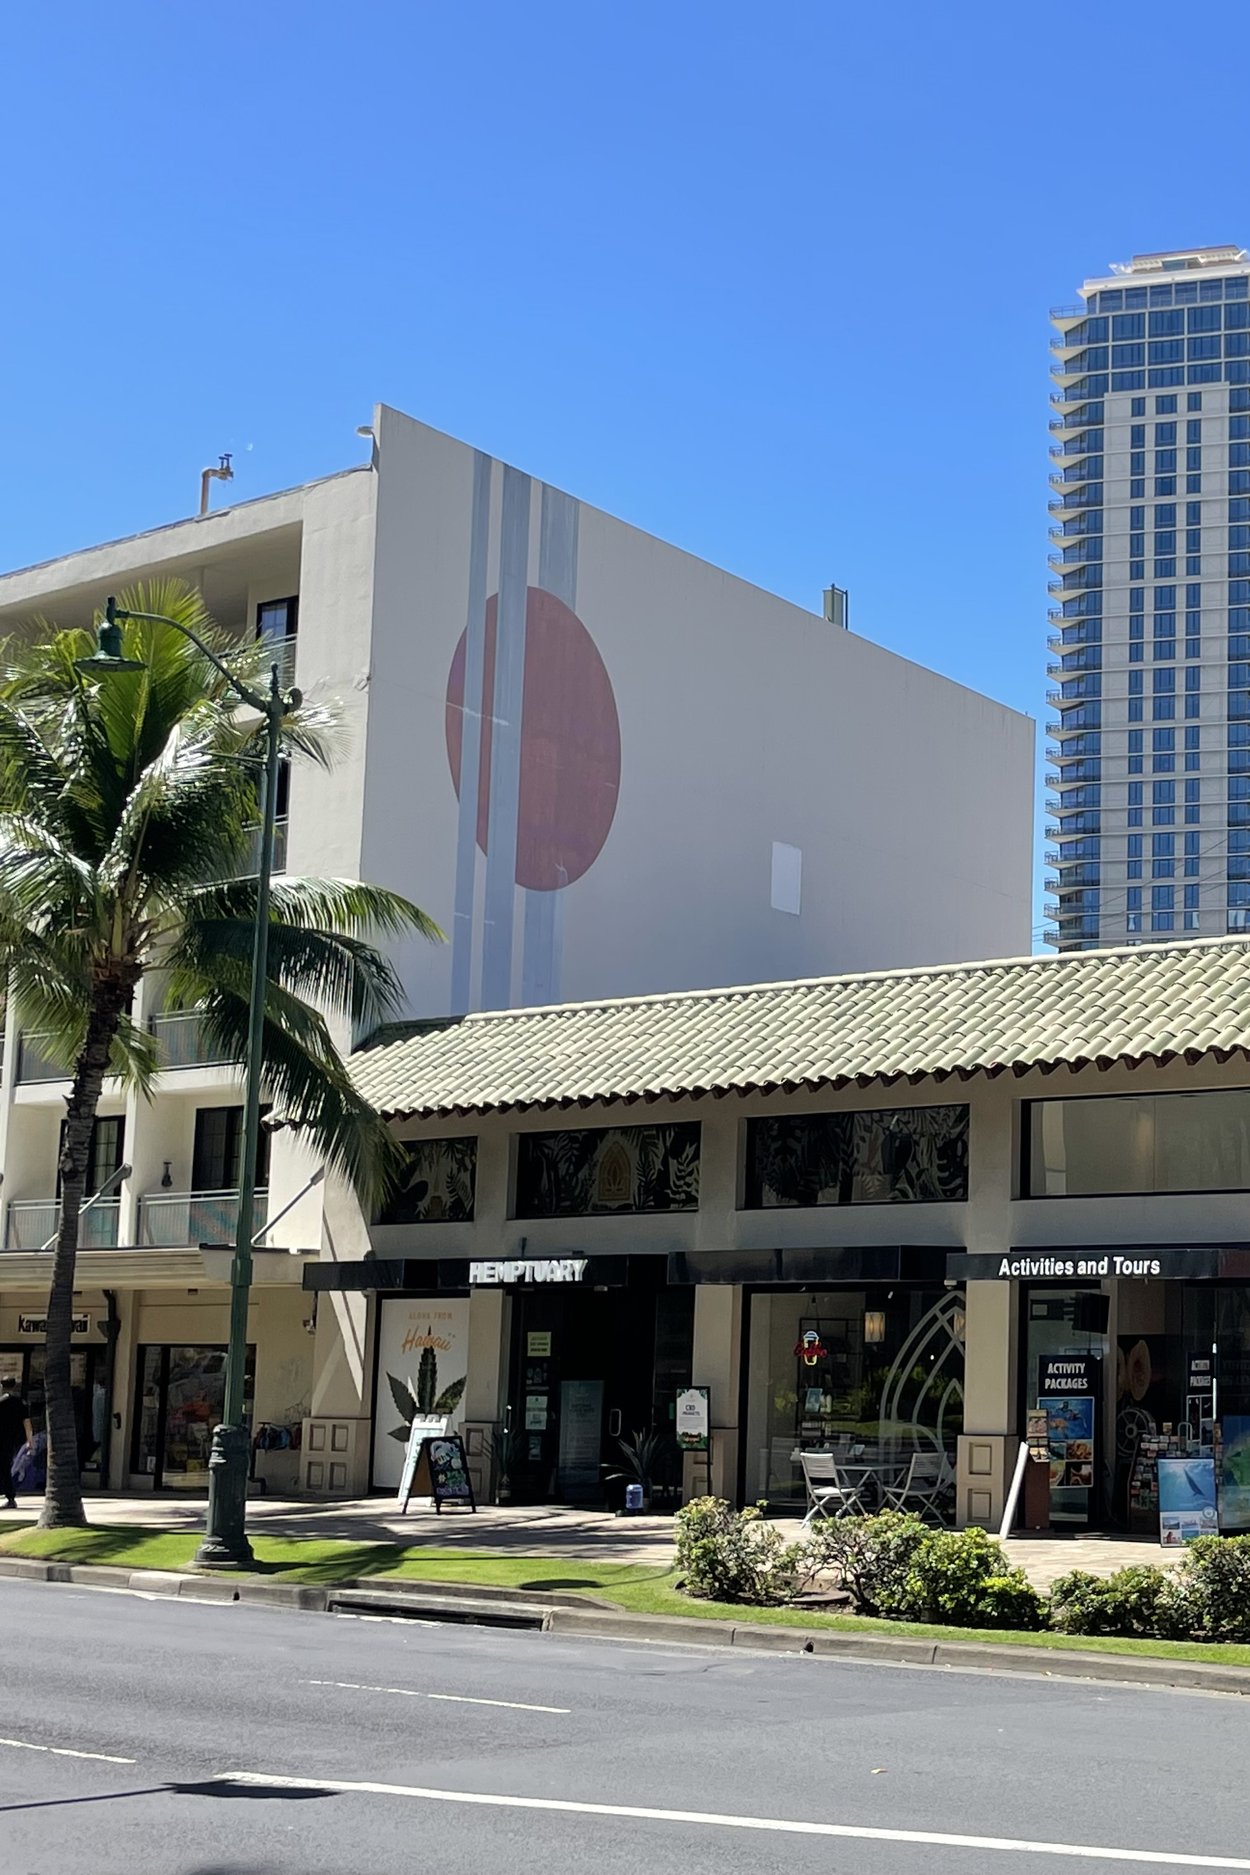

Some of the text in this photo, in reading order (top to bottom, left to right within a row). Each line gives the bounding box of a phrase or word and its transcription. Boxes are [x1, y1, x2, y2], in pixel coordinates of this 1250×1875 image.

[469, 1259, 588, 1283] HEMPTUARY
[999, 1256, 1161, 1276] Activities and Tours
[1047, 1363, 1086, 1374] ACTIVITY
[1044, 1378, 1089, 1390] PACKAGES
